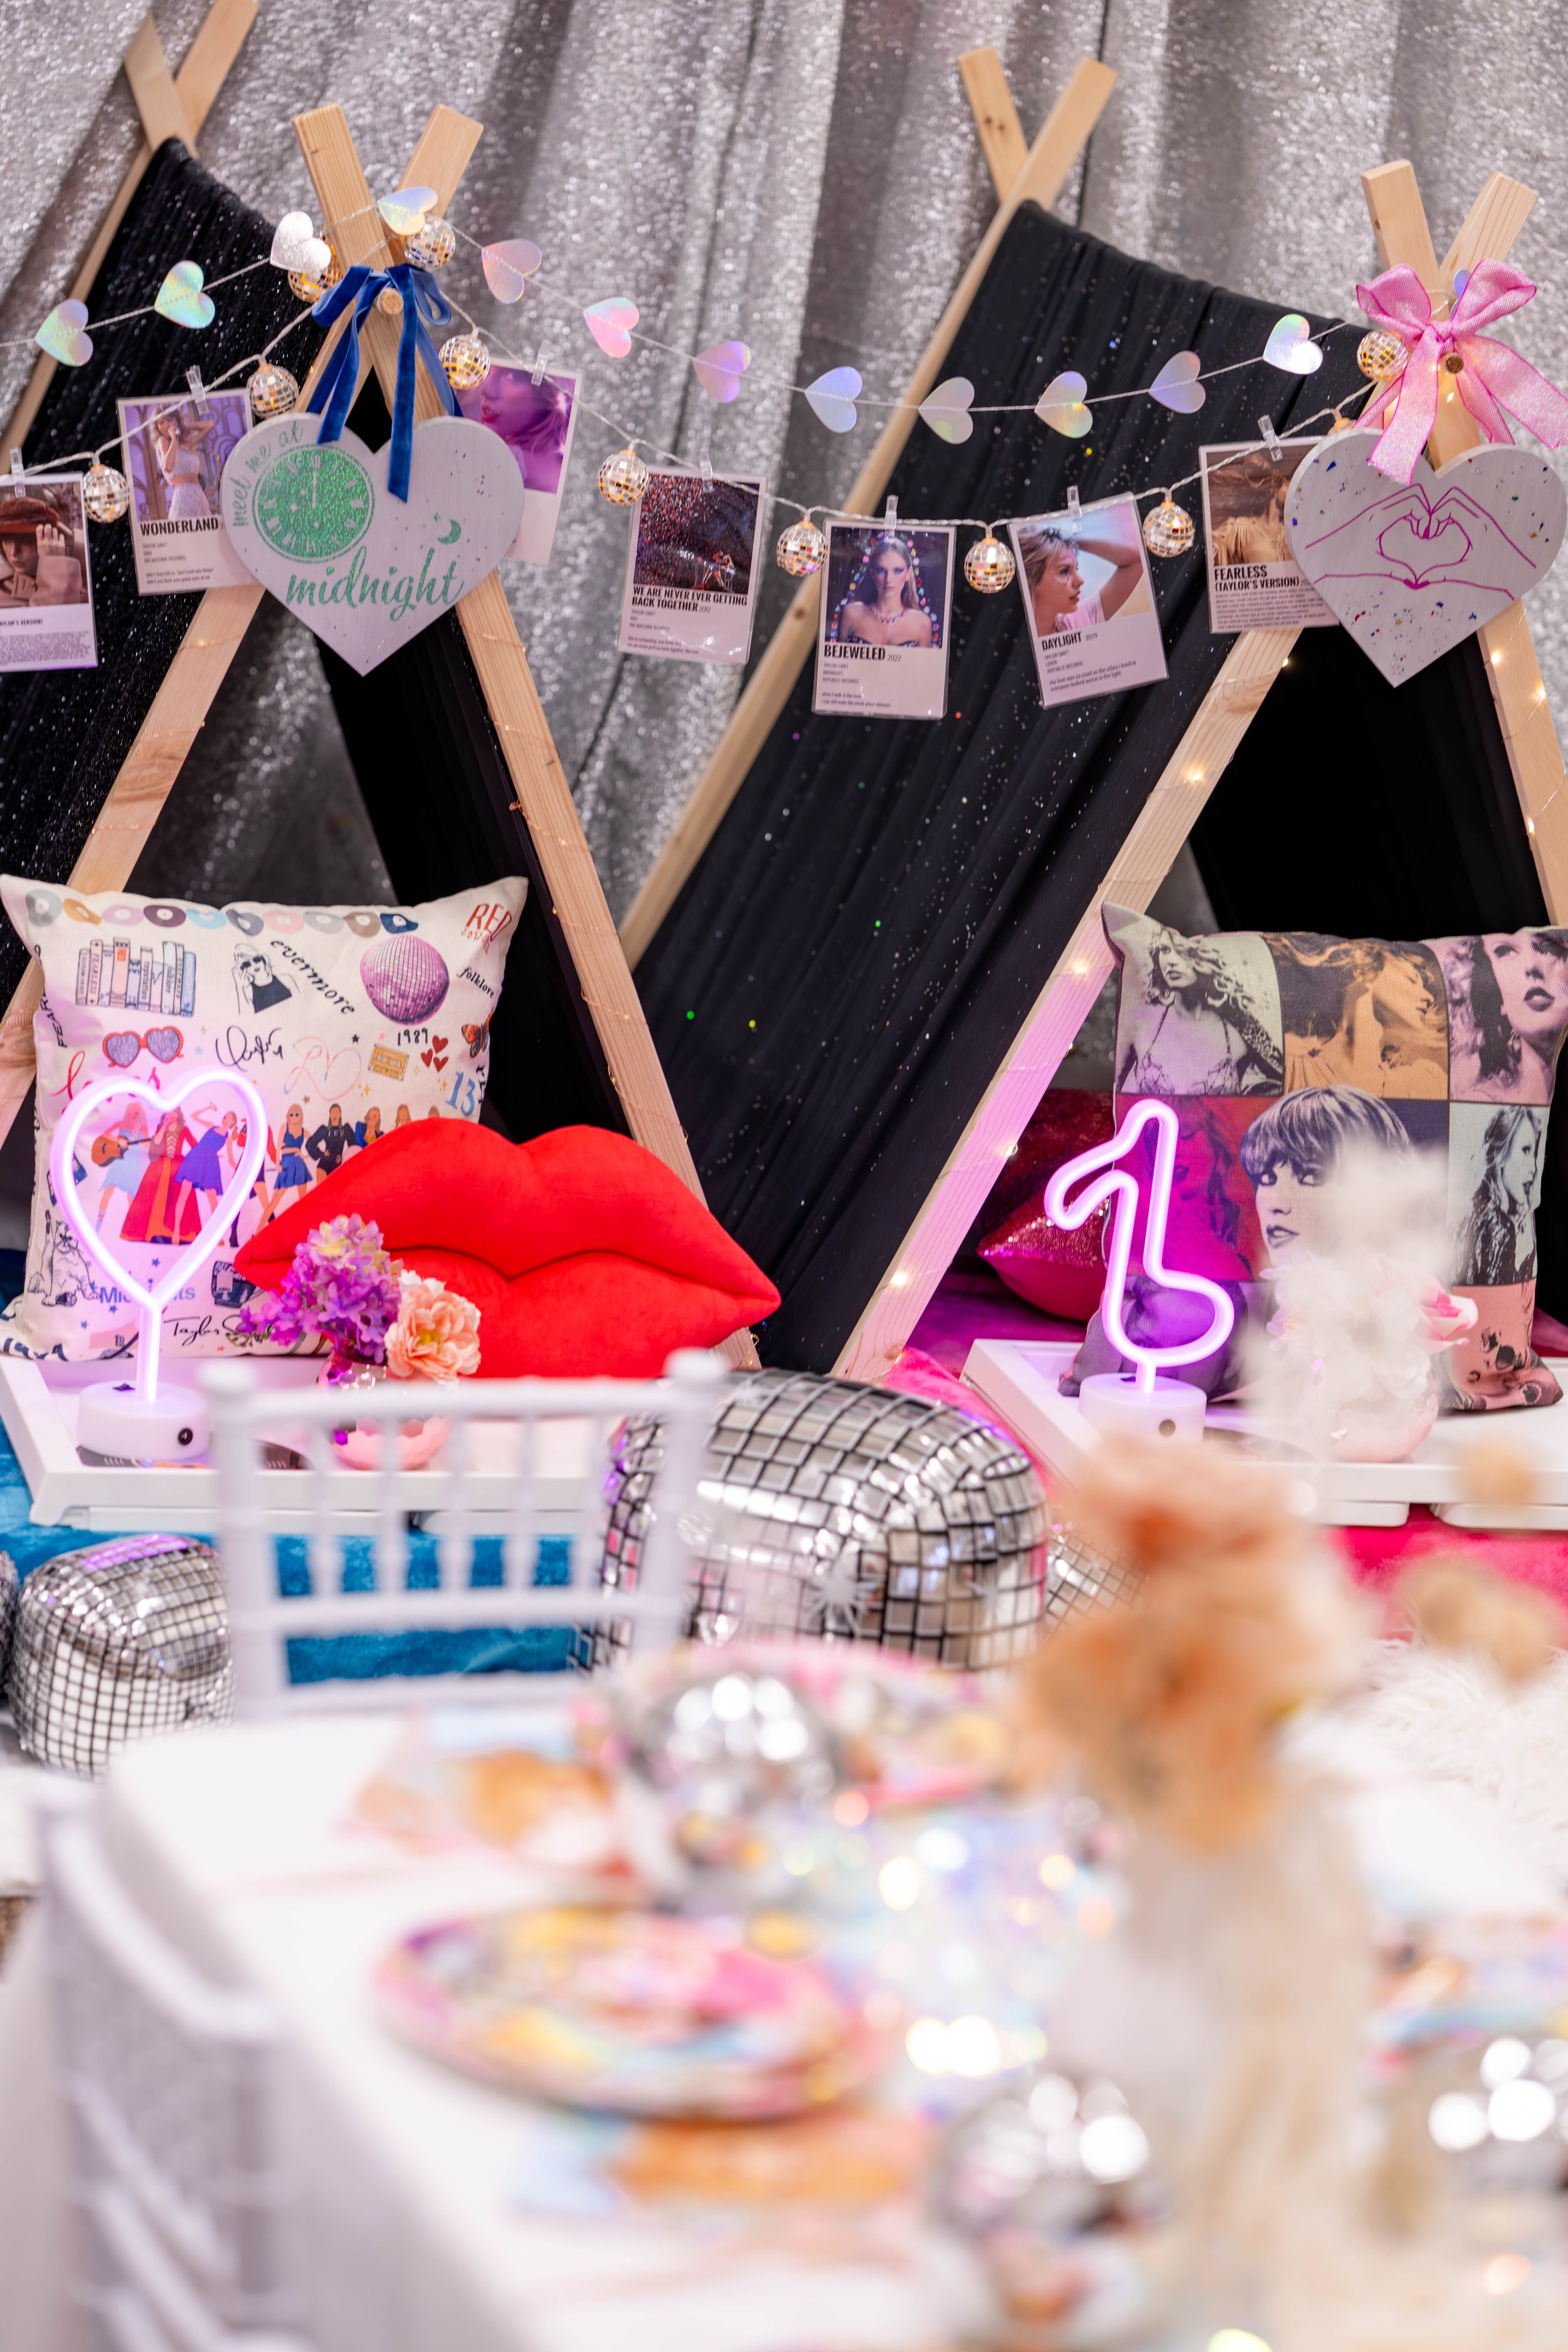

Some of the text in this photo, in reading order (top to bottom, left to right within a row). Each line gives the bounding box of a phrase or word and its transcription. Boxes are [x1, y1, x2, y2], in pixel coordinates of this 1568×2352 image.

[230, 420, 304, 527] meet me at
[140, 517, 219, 537] WONDERLAND
[1214, 565, 1268, 581] FEARLESS
[286, 546, 465, 622] midnight
[1216, 579, 1258, 592] (TAYLOR'S
[1260, 576, 1300, 589] VERSION)
[632, 596, 654, 607] BACK
[657, 599, 698, 613] TOGETHER
[633, 586, 748, 607] WE ARE NEVER EVER GETTING
[1041, 631, 1097, 651] DAYLIGHT 2019
[824, 645, 902, 663] BEJEWELED 2022
[466, 903, 512, 942] RED
[270, 940, 354, 1014] evermore
[457, 967, 495, 999] folklore
[398, 1029, 428, 1046] 1989
[445, 1071, 475, 1118] 13
[163, 1315, 220, 1347] Taylor
